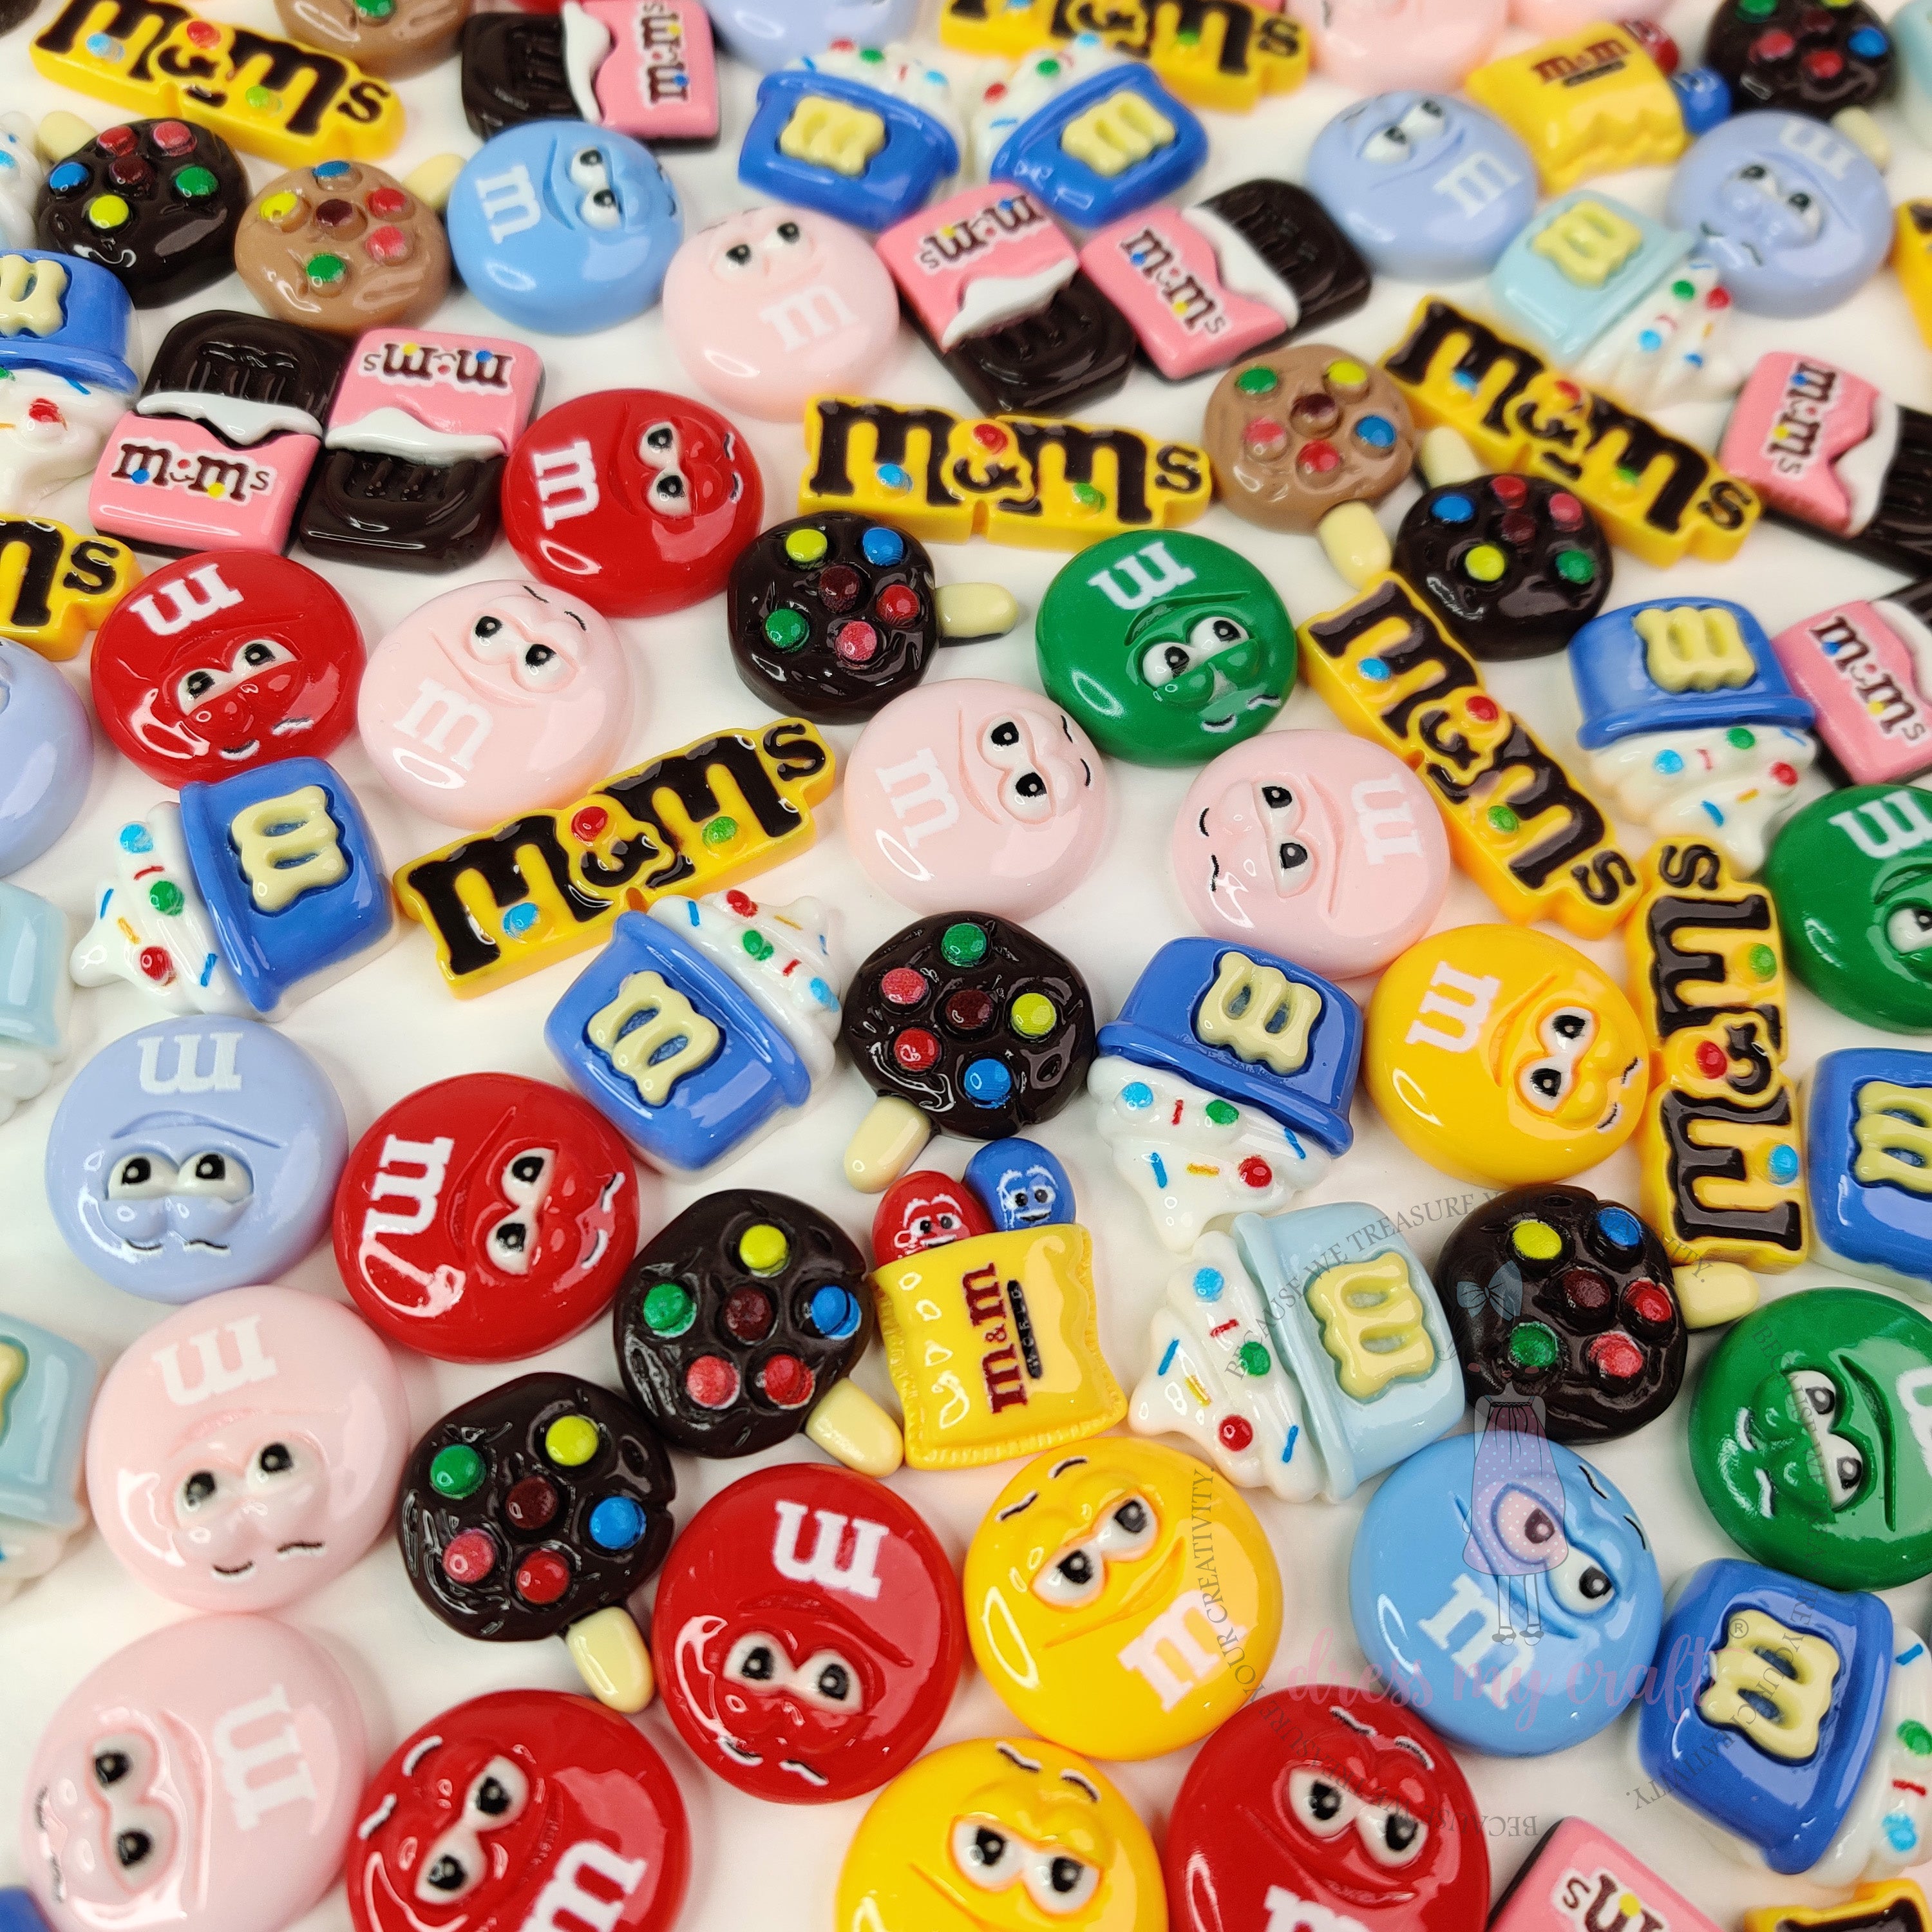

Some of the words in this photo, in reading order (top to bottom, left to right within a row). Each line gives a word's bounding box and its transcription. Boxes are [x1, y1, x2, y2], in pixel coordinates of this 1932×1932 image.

[475, 165, 542, 245] m
[759, 285, 858, 352] m
[533, 441, 600, 529] m
[129, 564, 243, 636] m
[1087, 541, 1198, 610] m
[393, 678, 493, 770] m
[876, 747, 961, 849] m
[1351, 773, 1425, 866] m
[231, 786, 348, 912] m
[587, 969, 720, 1104] m
[1197, 951, 1323, 1075] m
[1407, 960, 1502, 1054] m
[137, 1032, 243, 1094] m
[363, 1133, 454, 1238] m
[152, 1315, 279, 1405] m
[961, 1262, 1029, 1414] m&m
[773, 1501, 889, 1600] m
[1117, 1589, 1248, 1714] m
[213, 1683, 319, 1832] m
